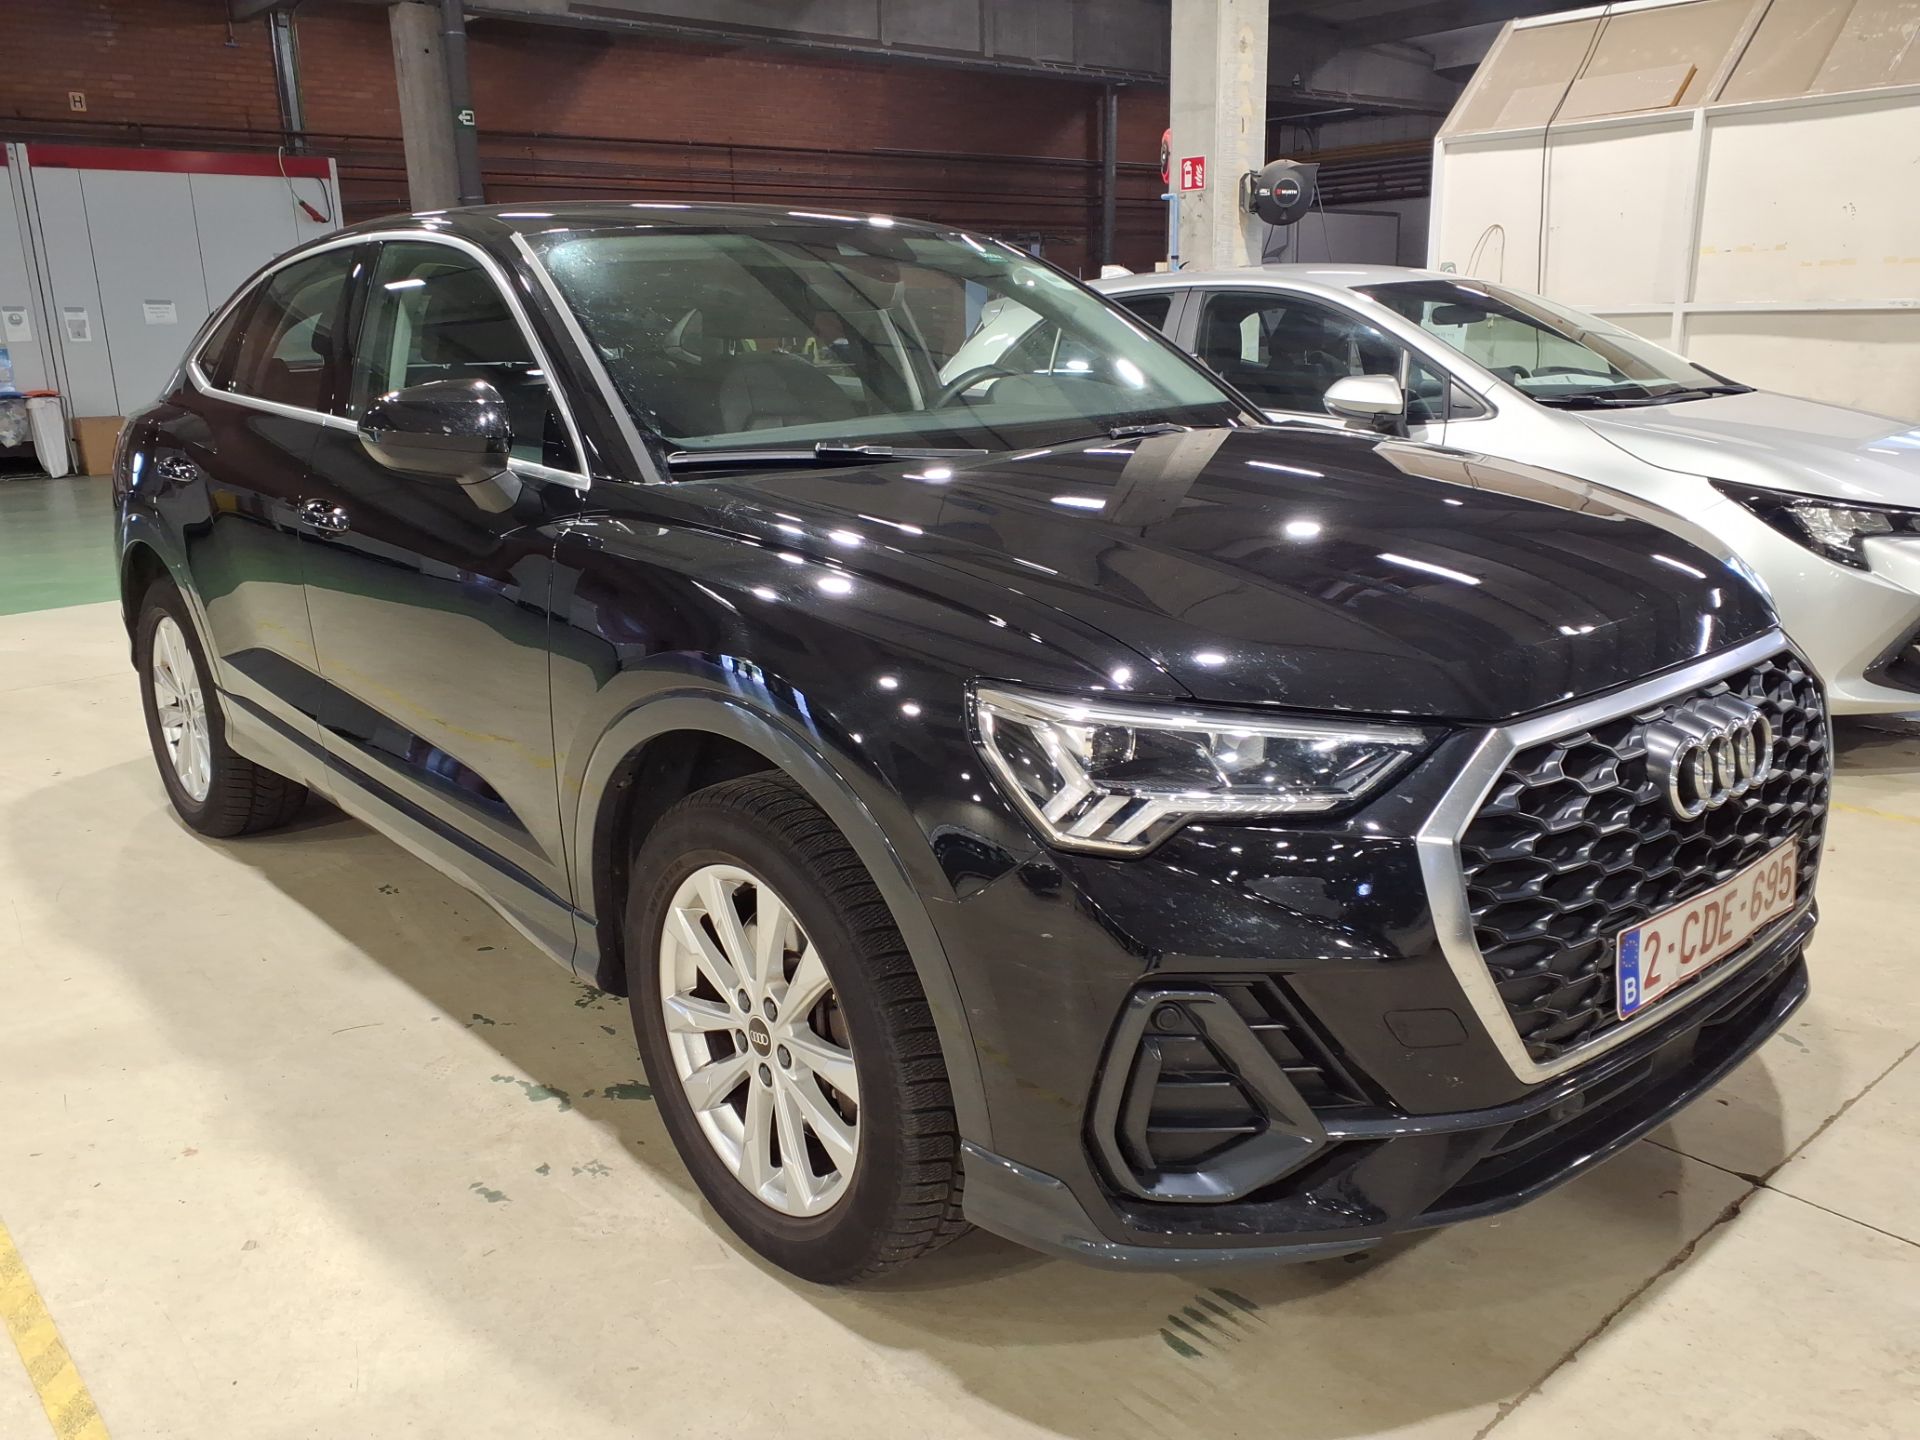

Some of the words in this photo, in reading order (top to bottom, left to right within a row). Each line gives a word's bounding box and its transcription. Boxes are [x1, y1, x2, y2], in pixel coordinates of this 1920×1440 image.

[72, 95, 83, 109] H
[1644, 851, 1793, 990] 2-CDE-695
[1624, 976, 1637, 1005] B
